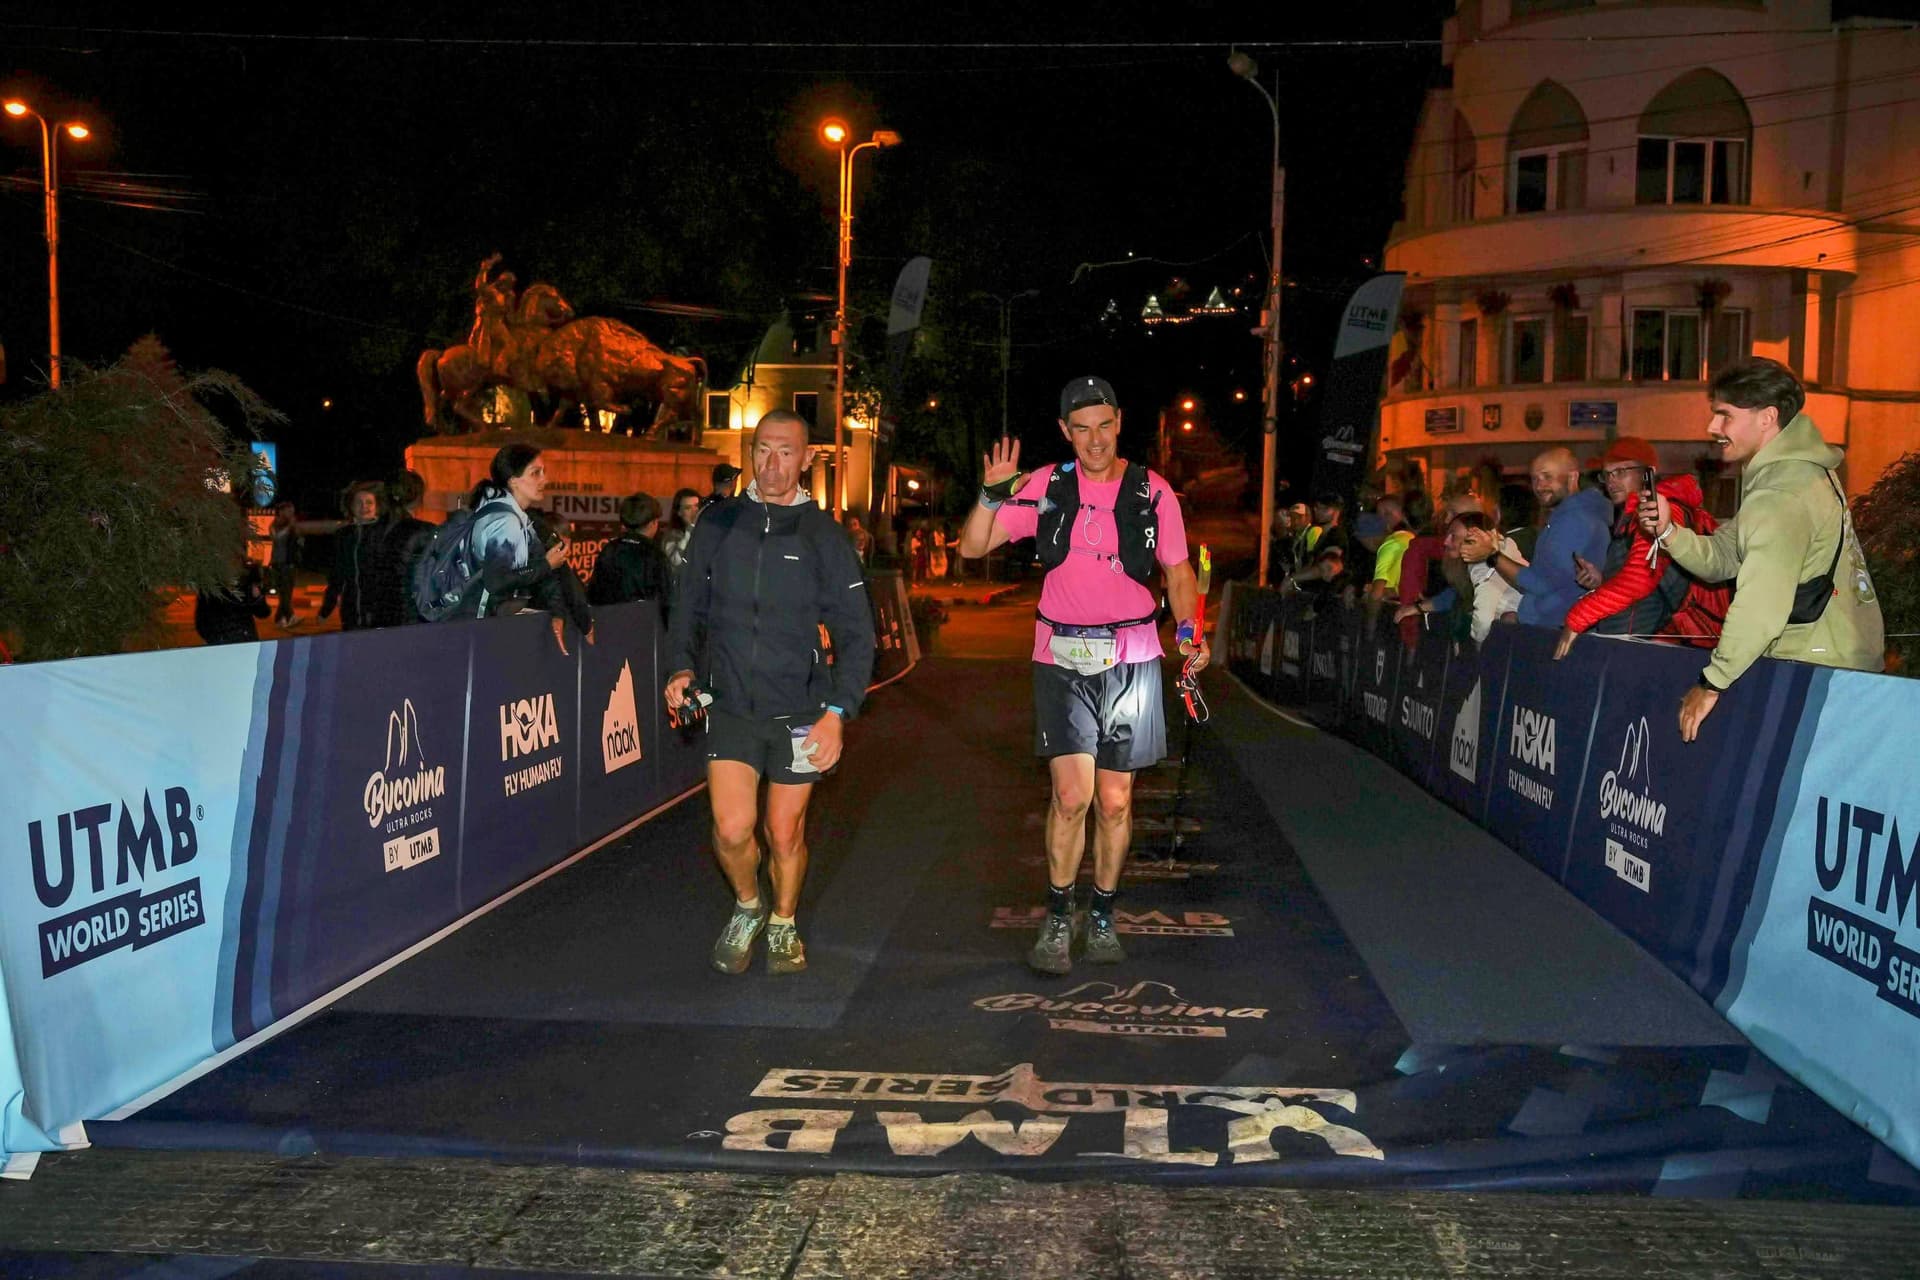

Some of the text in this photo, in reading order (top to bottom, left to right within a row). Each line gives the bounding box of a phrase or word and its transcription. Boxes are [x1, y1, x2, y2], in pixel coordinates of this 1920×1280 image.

[1363, 690, 1388, 723] TUDOR
[1401, 695, 1434, 740] SUUNTO
[500, 693, 560, 762] HOKA
[607, 720, 637, 760] näak
[1510, 704, 1556, 776] HOKA
[364, 761, 445, 828] Bucovina
[504, 756, 562, 797] FLY HUMAN FLY
[1508, 768, 1554, 810] FLY HUMAN FLY
[386, 807, 433, 834] ULTRA ROCKS
[1600, 770, 1667, 837] Bucovina
[28, 786, 199, 908] UTMB
[388, 836, 434, 864] BY UTMB
[1610, 822, 1649, 849] ULTRA ROCKS
[1608, 845, 1645, 884] BY UTMB
[47, 890, 199, 962] WORLD SERIES
[990, 905, 1230, 926] UMB
[1813, 910, 1882, 970] WORLD
[972, 992, 1271, 1020] Bucovina
[1110, 1024, 1200, 1035] UTMB
[782, 1073, 1011, 1097] SERIES
